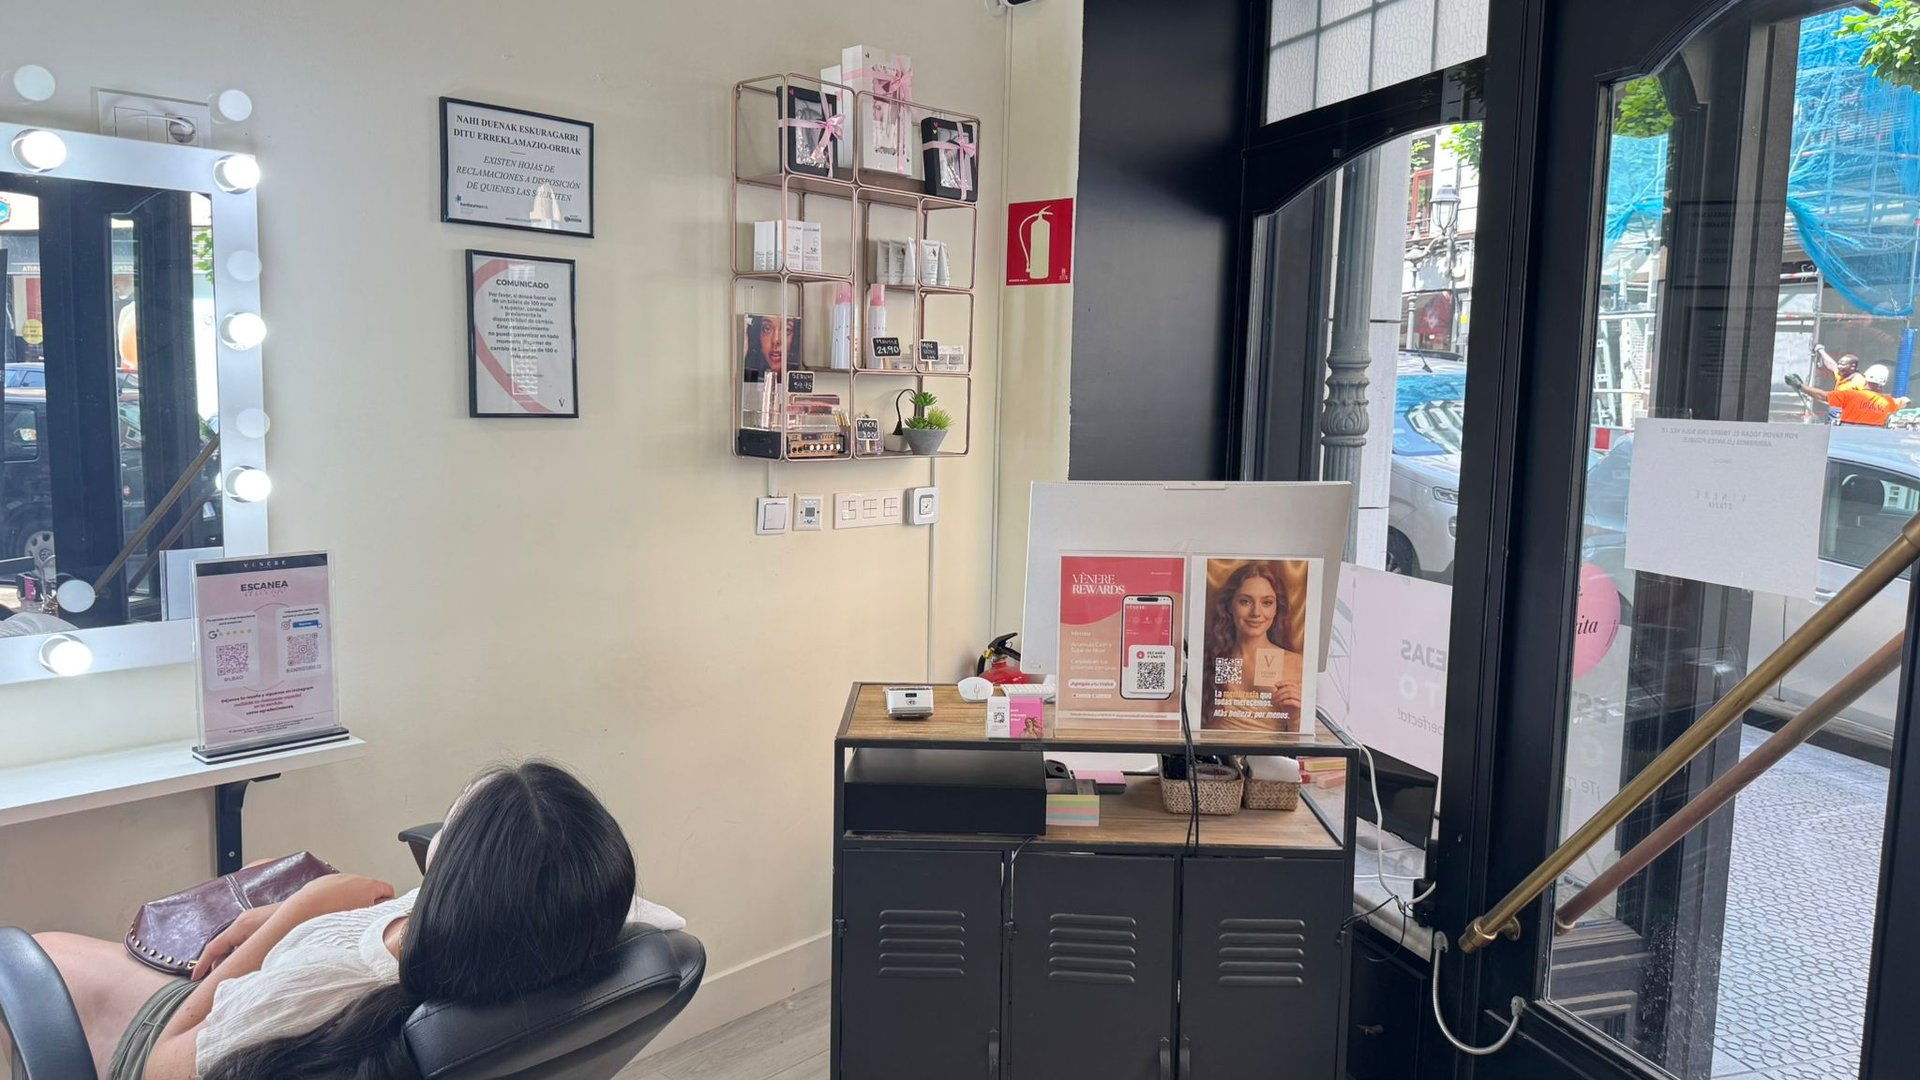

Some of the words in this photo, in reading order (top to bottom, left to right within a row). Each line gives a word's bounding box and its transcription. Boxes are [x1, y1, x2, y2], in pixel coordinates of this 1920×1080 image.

[456, 114, 479, 126] NAHI
[481, 119, 517, 132] DUENAK
[519, 125, 579, 142] ESKURAGARRI
[453, 128, 476, 138] DITU
[477, 132, 582, 156] ERREKLAMAZIO-ORRIAK
[483, 156, 516, 168] EXISTEN
[517, 160, 543, 172] HOJAS
[544, 165, 555, 174] DE
[456, 166, 524, 182] RECLAMACIONES
[532, 176, 581, 190] DISPOSICIÓN
[466, 181, 478, 190] DE
[480, 183, 515, 195] QUIENES
[516, 188, 532, 196] LAS
[496, 278, 550, 290] COMUNICADO
[240, 580, 288, 592] ESCANEA
[1072, 584, 1126, 595] REWARDS
[1264, 655, 1275, 668] V
[1214, 690, 1222, 698] La
[1260, 692, 1272, 700] que
[1214, 698, 1232, 706] todas
[1234, 699, 1273, 707] merecemos.
[1214, 708, 1228, 716] Más
[1266, 712, 1290, 720] menos.
